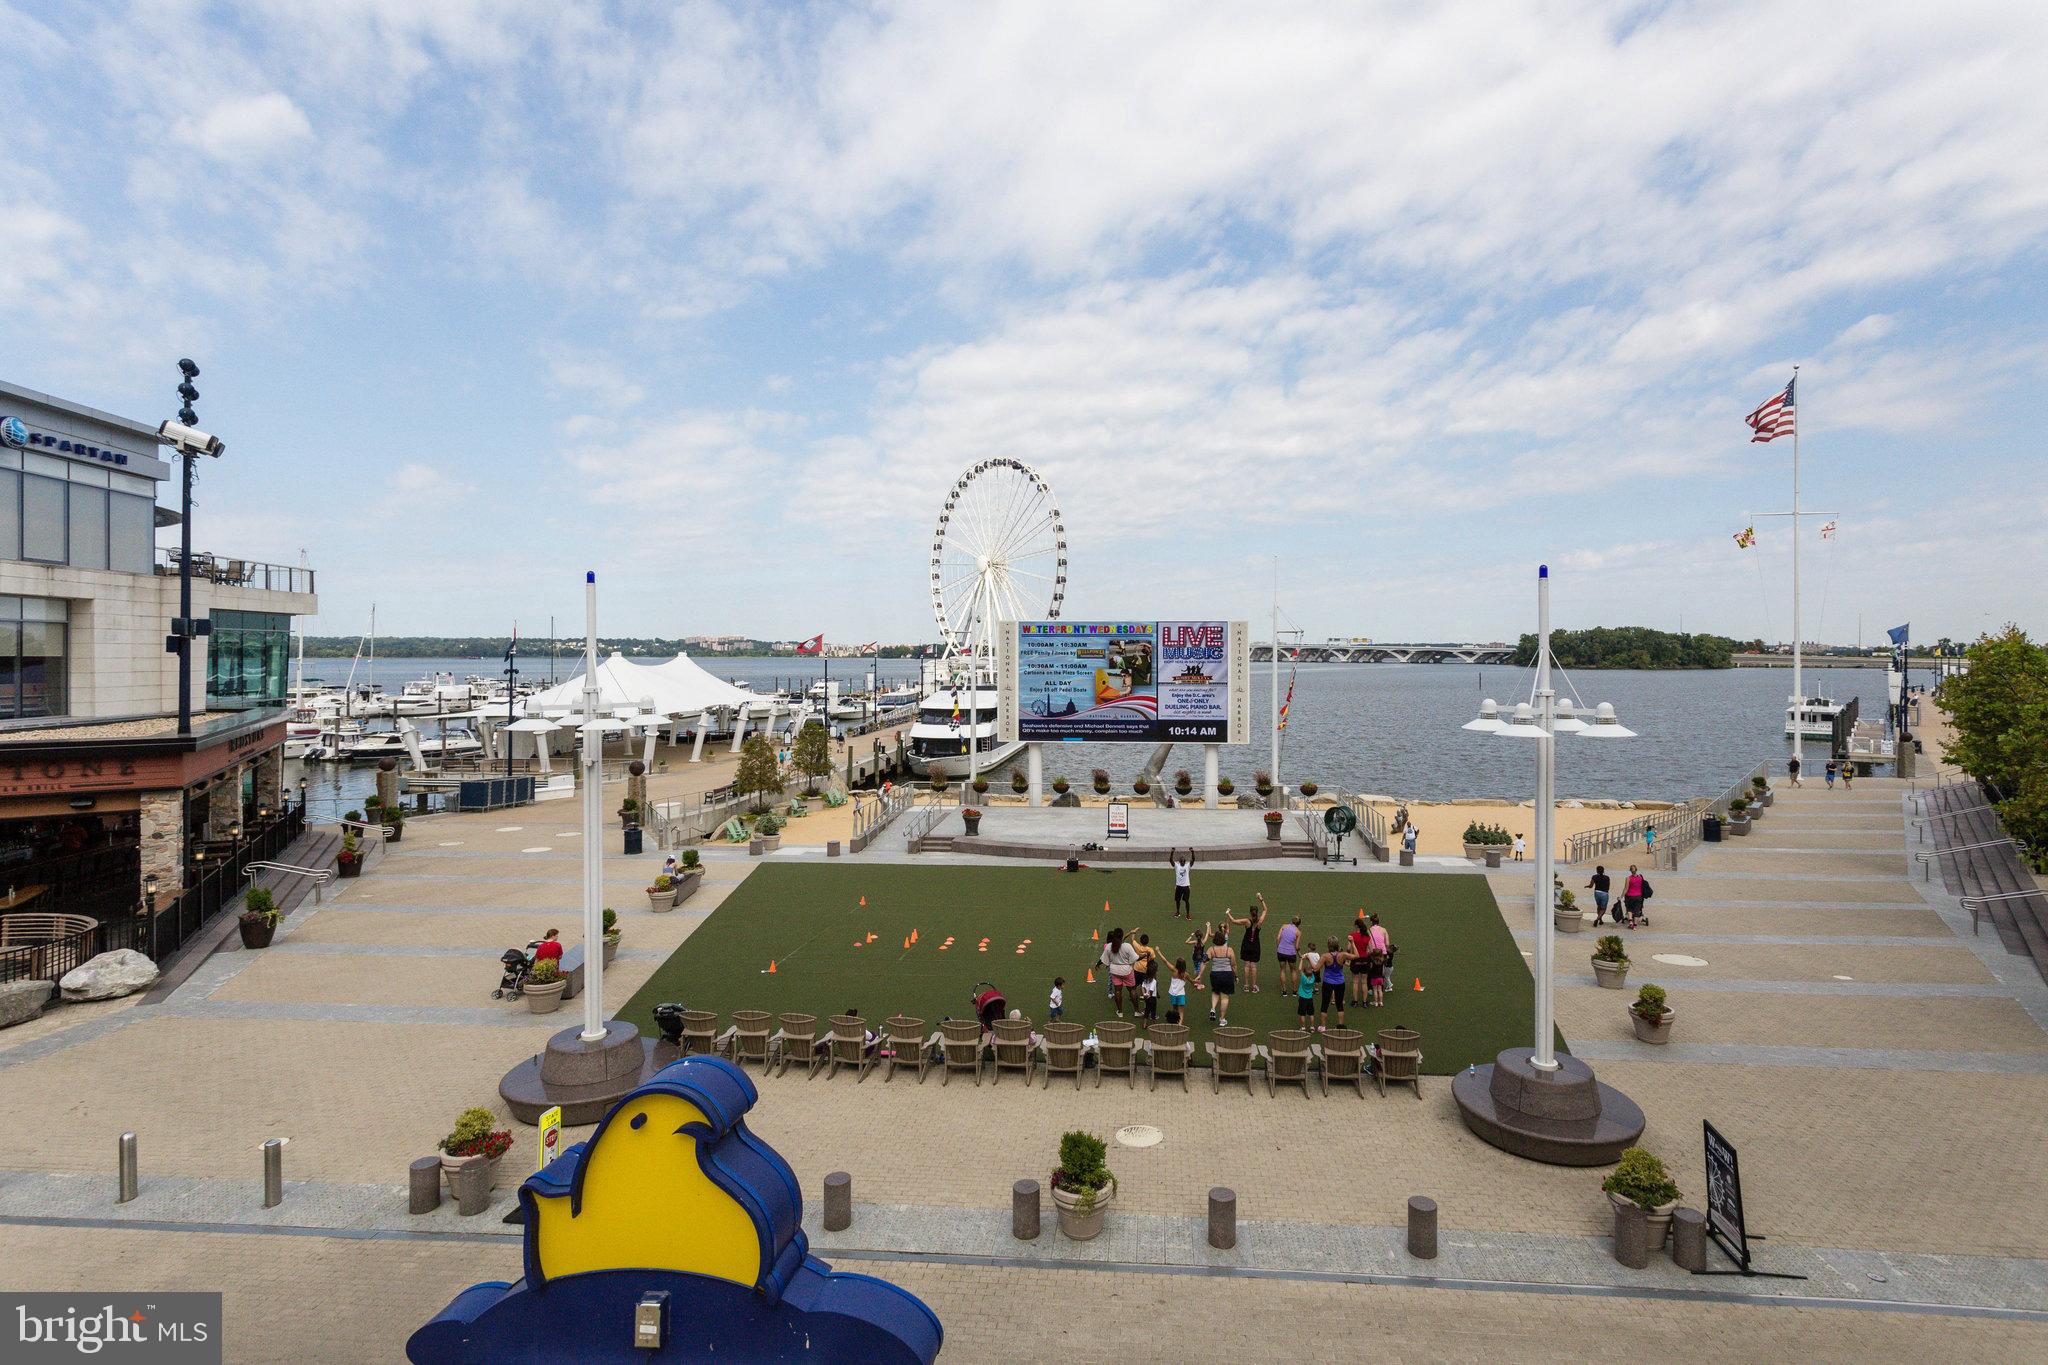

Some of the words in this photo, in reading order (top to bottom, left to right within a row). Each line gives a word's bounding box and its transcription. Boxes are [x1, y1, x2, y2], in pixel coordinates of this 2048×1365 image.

[30, 432, 128, 465] SPARTAN
[1022, 625, 1086, 634] WATERFRONT
[1088, 625, 1152, 634] WEDNESDAYS
[1162, 626, 1224, 647] LIVE
[1163, 647, 1224, 660] MUSIC
[1169, 727, 1197, 735] 10:14
[1200, 727, 1216, 735] AM
